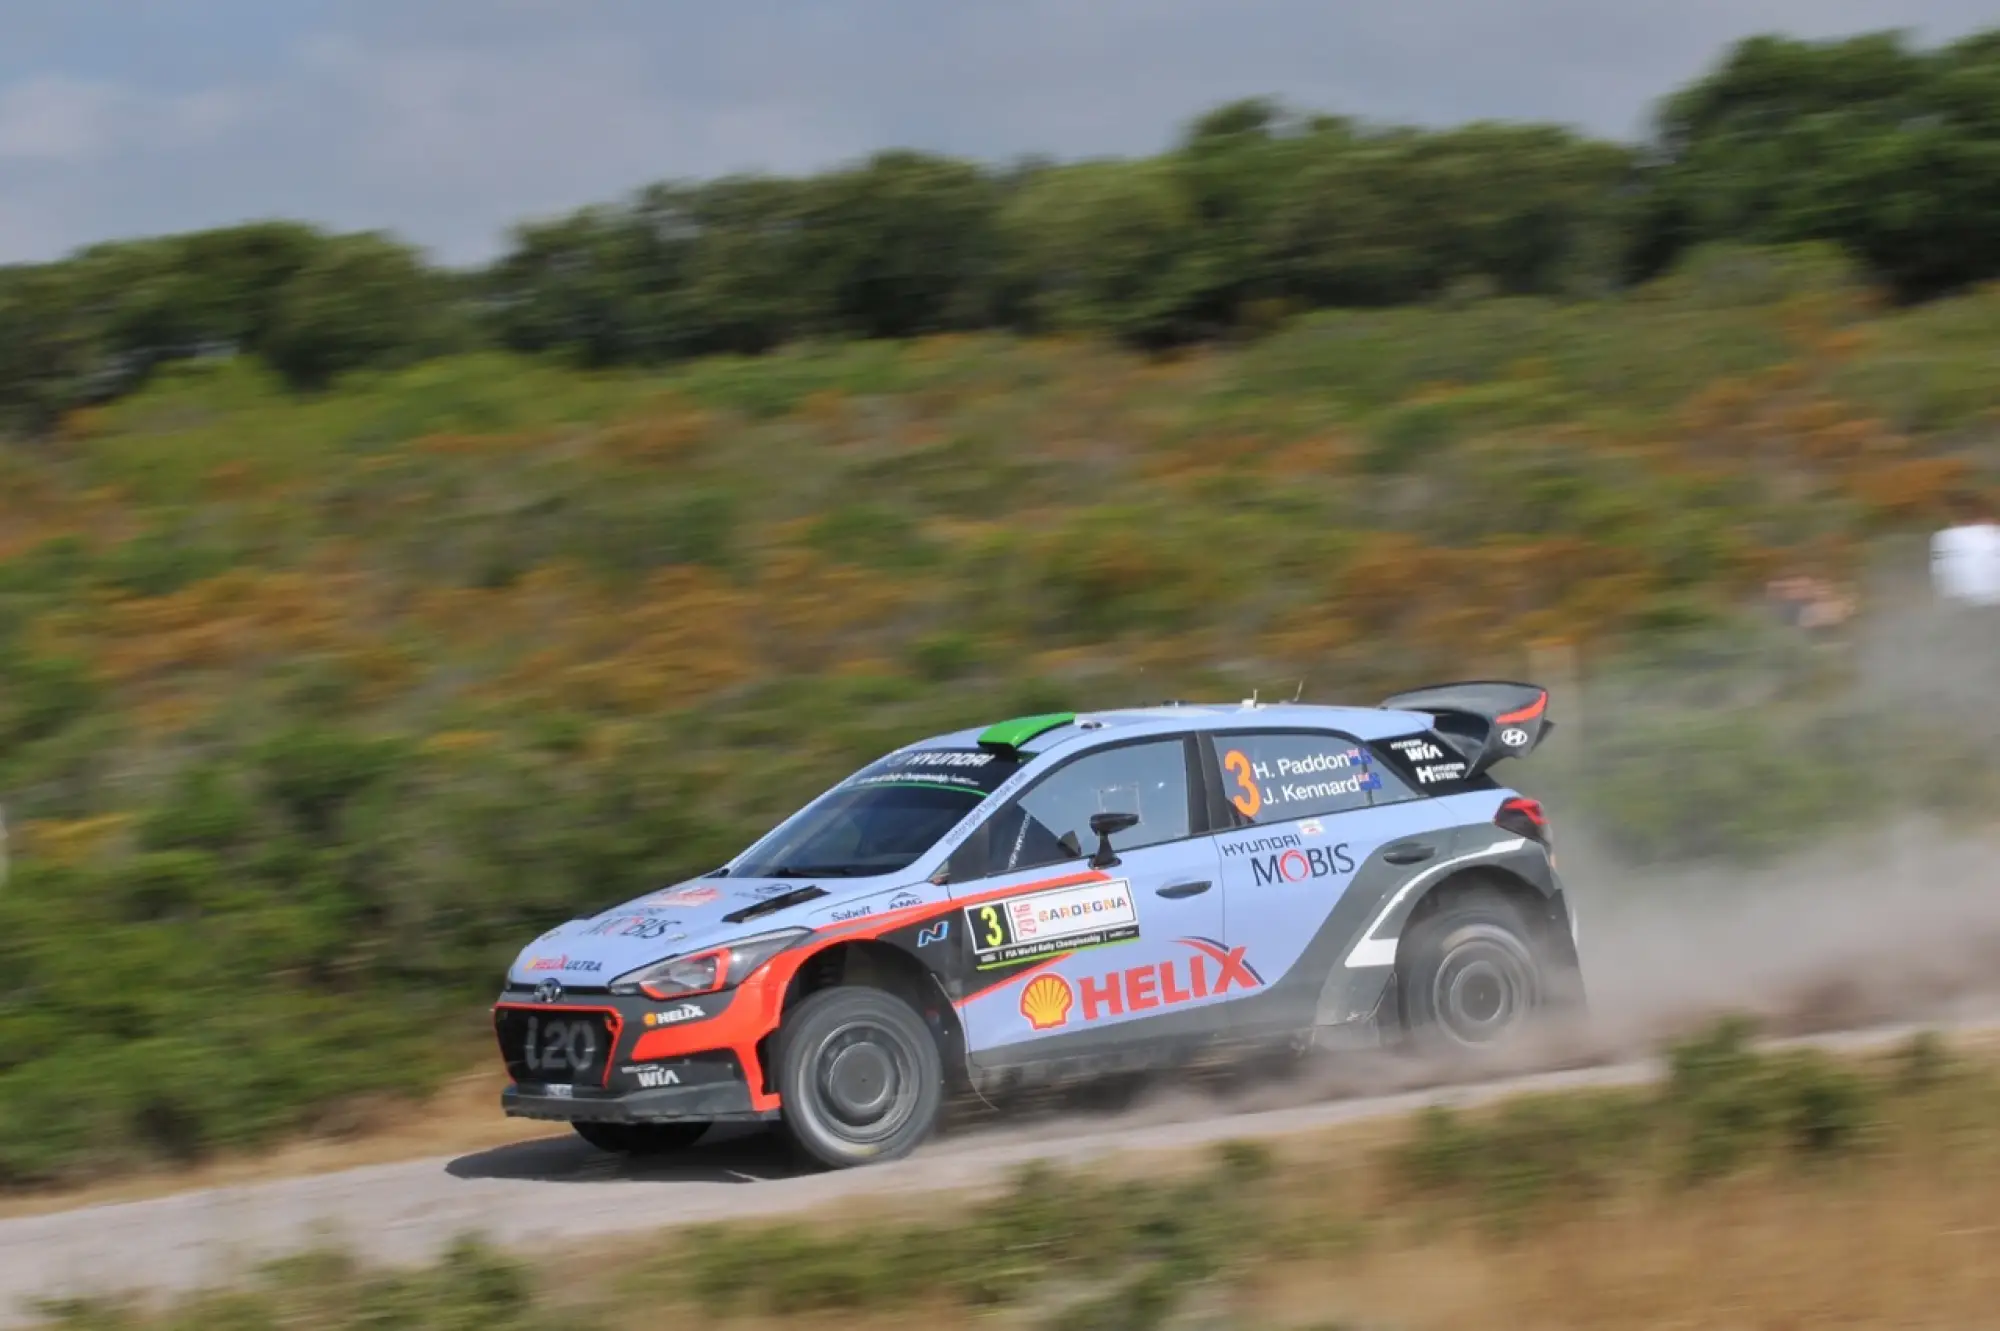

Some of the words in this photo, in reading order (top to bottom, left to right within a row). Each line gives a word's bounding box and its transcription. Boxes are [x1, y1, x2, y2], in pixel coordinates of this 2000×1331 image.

[905, 752, 997, 768] HYUNDAI
[1252, 762, 1275, 780] H.
[1277, 752, 1350, 777] Paddon
[1224, 749, 1261, 818] 3
[1263, 785, 1279, 805] J.
[1283, 776, 1362, 802] Kennard
[1222, 834, 1303, 857] HYUNDAI
[1251, 843, 1356, 887] MOBIS
[1039, 896, 1128, 923] SARDEGNA
[980, 906, 1003, 946] 3
[565, 959, 603, 972] ULTRA
[1077, 944, 1260, 1020] HELIX
[656, 1004, 706, 1024] HELIX
